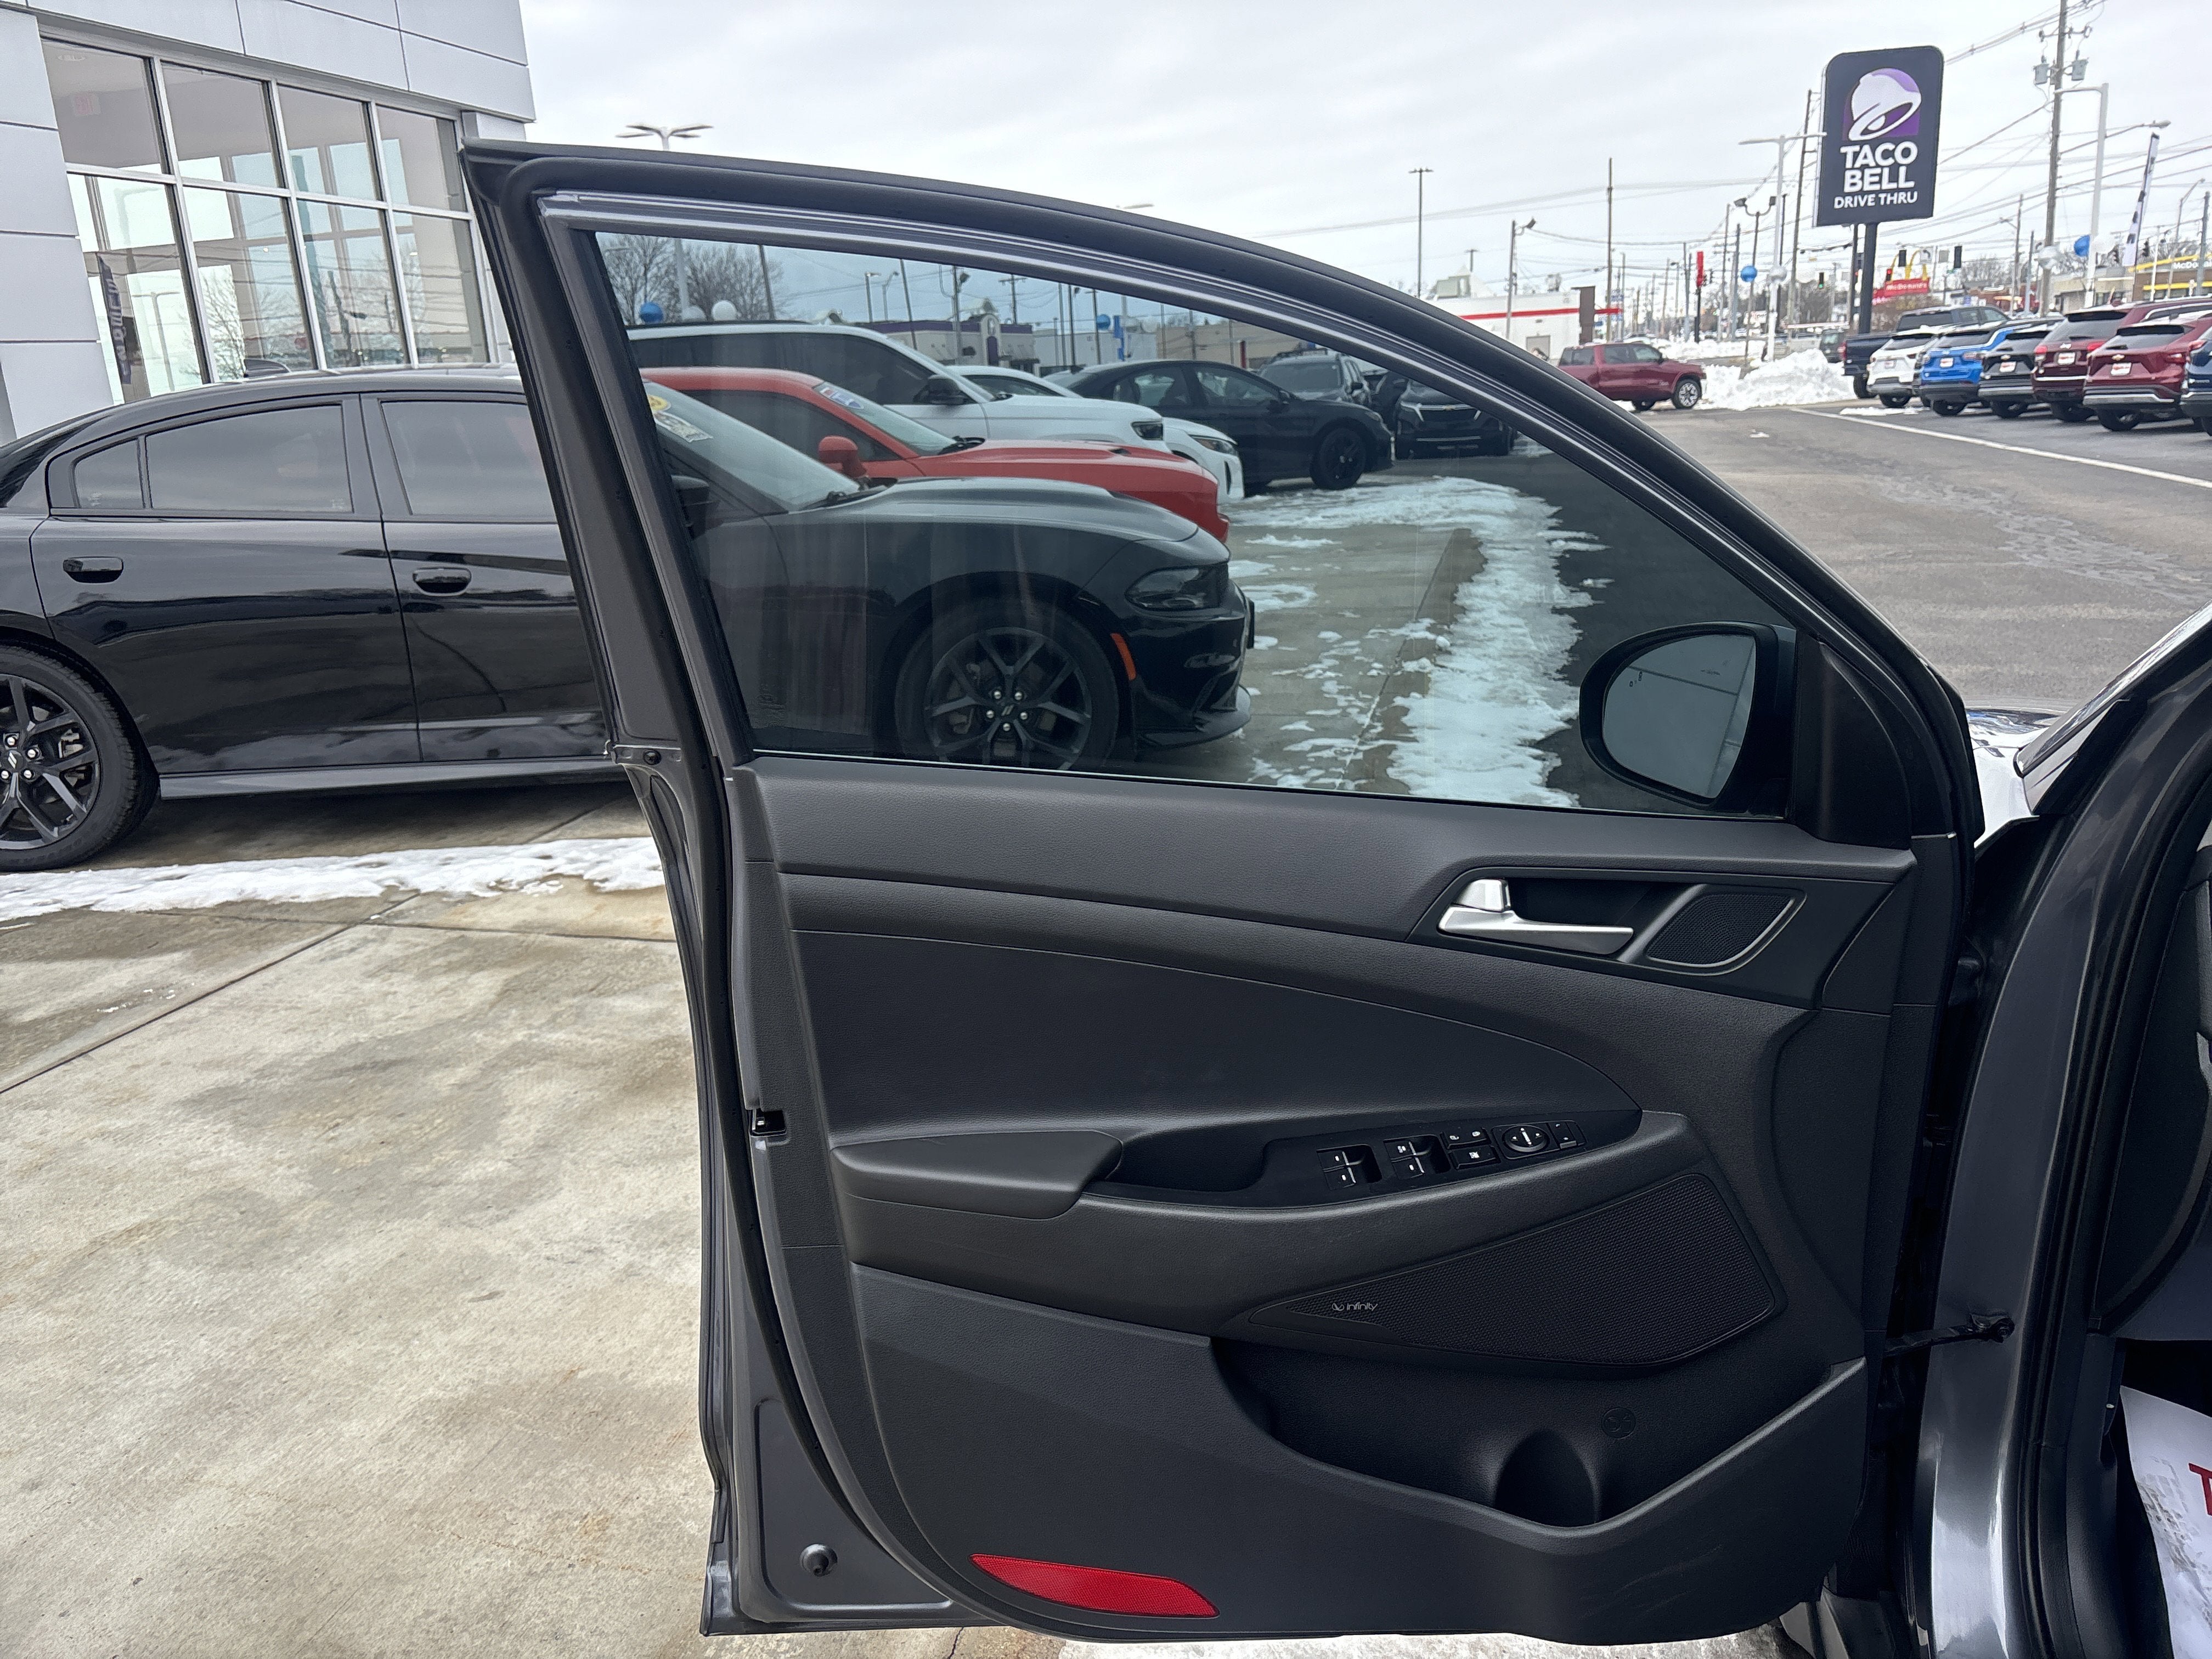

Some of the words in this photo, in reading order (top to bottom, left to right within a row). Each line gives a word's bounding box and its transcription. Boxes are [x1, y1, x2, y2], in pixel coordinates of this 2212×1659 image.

[1839, 140, 1918, 169] TACO
[1843, 165, 1915, 193] BELL
[1833, 193, 1876, 209] DRIVE
[1878, 190, 1918, 206] THRU
